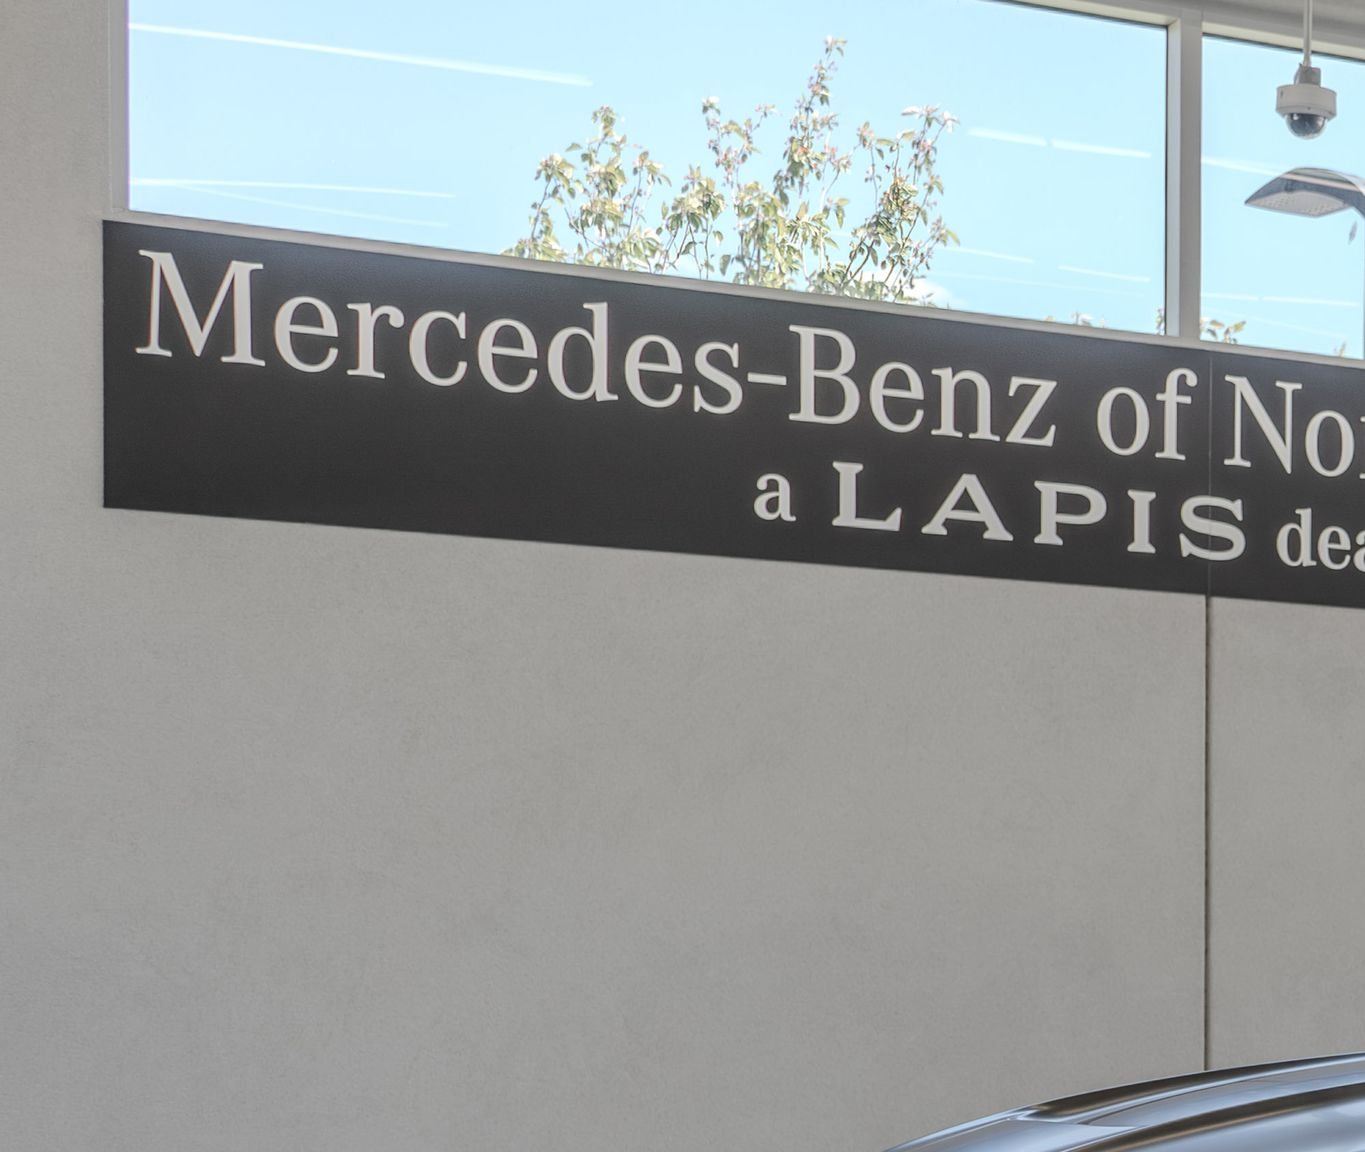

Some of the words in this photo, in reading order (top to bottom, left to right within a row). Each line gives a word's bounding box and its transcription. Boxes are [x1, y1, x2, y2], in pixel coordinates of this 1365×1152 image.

[135, 249, 1057, 447] Mercedes-Benz
[1096, 367, 1198, 461] of
[753, 473, 798, 523] a
[831, 461, 1246, 561] LAPIS
